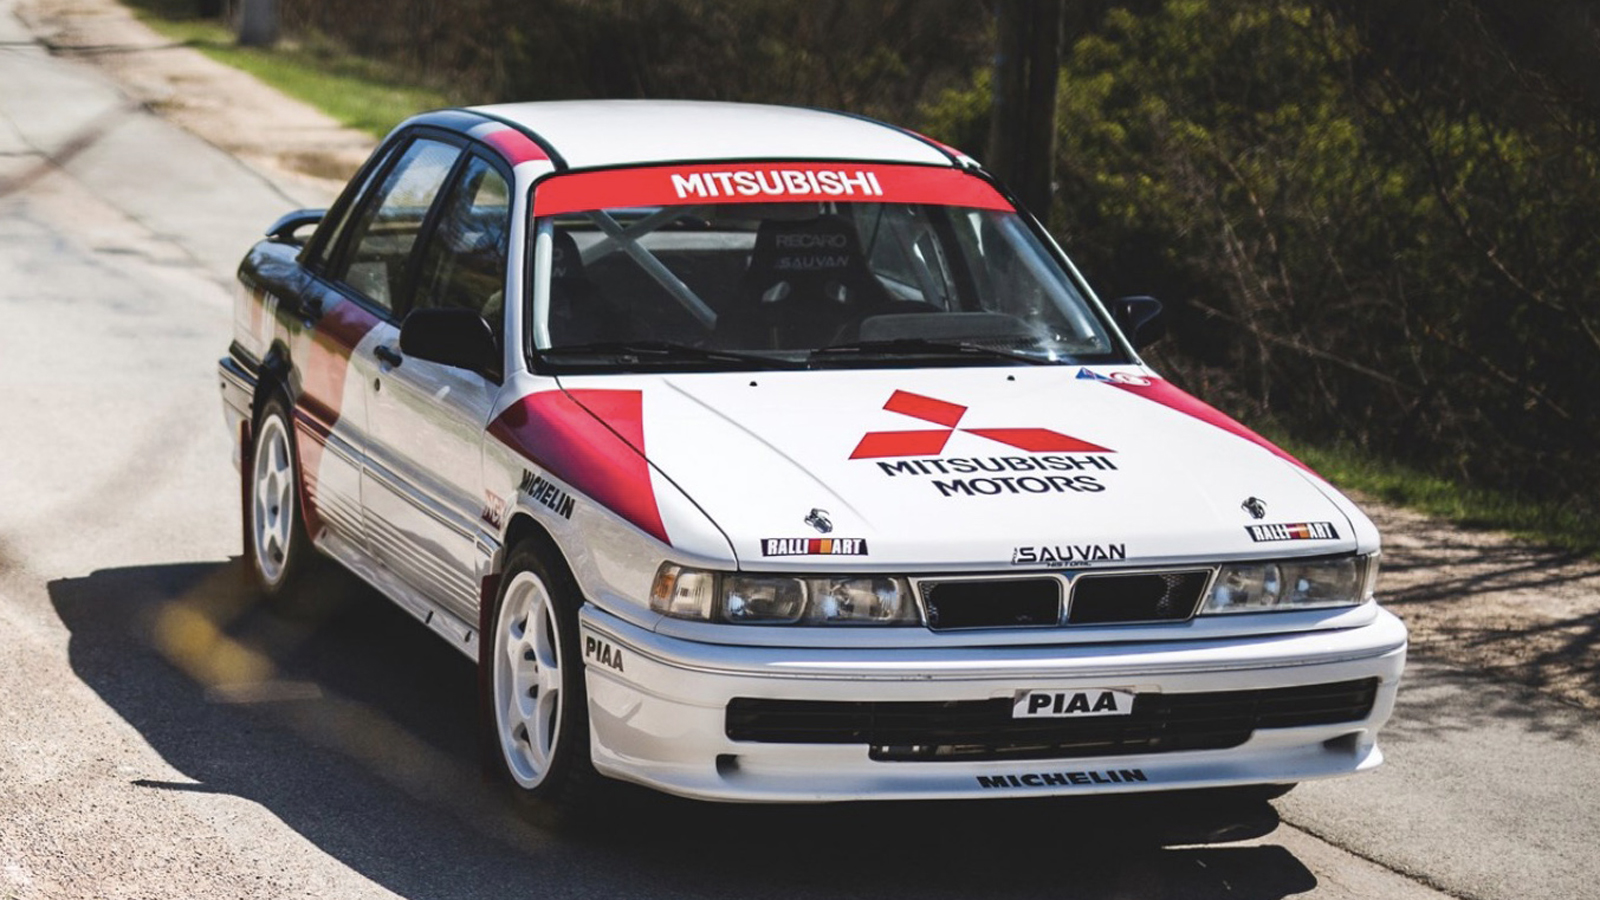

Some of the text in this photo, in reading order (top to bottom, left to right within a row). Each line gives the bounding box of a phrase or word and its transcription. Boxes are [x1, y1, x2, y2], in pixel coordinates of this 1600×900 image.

[671, 170, 883, 198] MITSUBISHI
[775, 234, 847, 248] RECARO
[778, 255, 849, 269] SAUVAN
[876, 456, 1119, 476] MITSUBISHI
[518, 468, 575, 520] MICHELIN
[931, 476, 1106, 497] MOTORS
[767, 539, 862, 555] RALLI ART
[1017, 543, 1125, 562] SAUVAN
[585, 635, 624, 673] PIAA
[1027, 691, 1118, 714] PIAA
[976, 768, 1148, 788] MICHELIN
